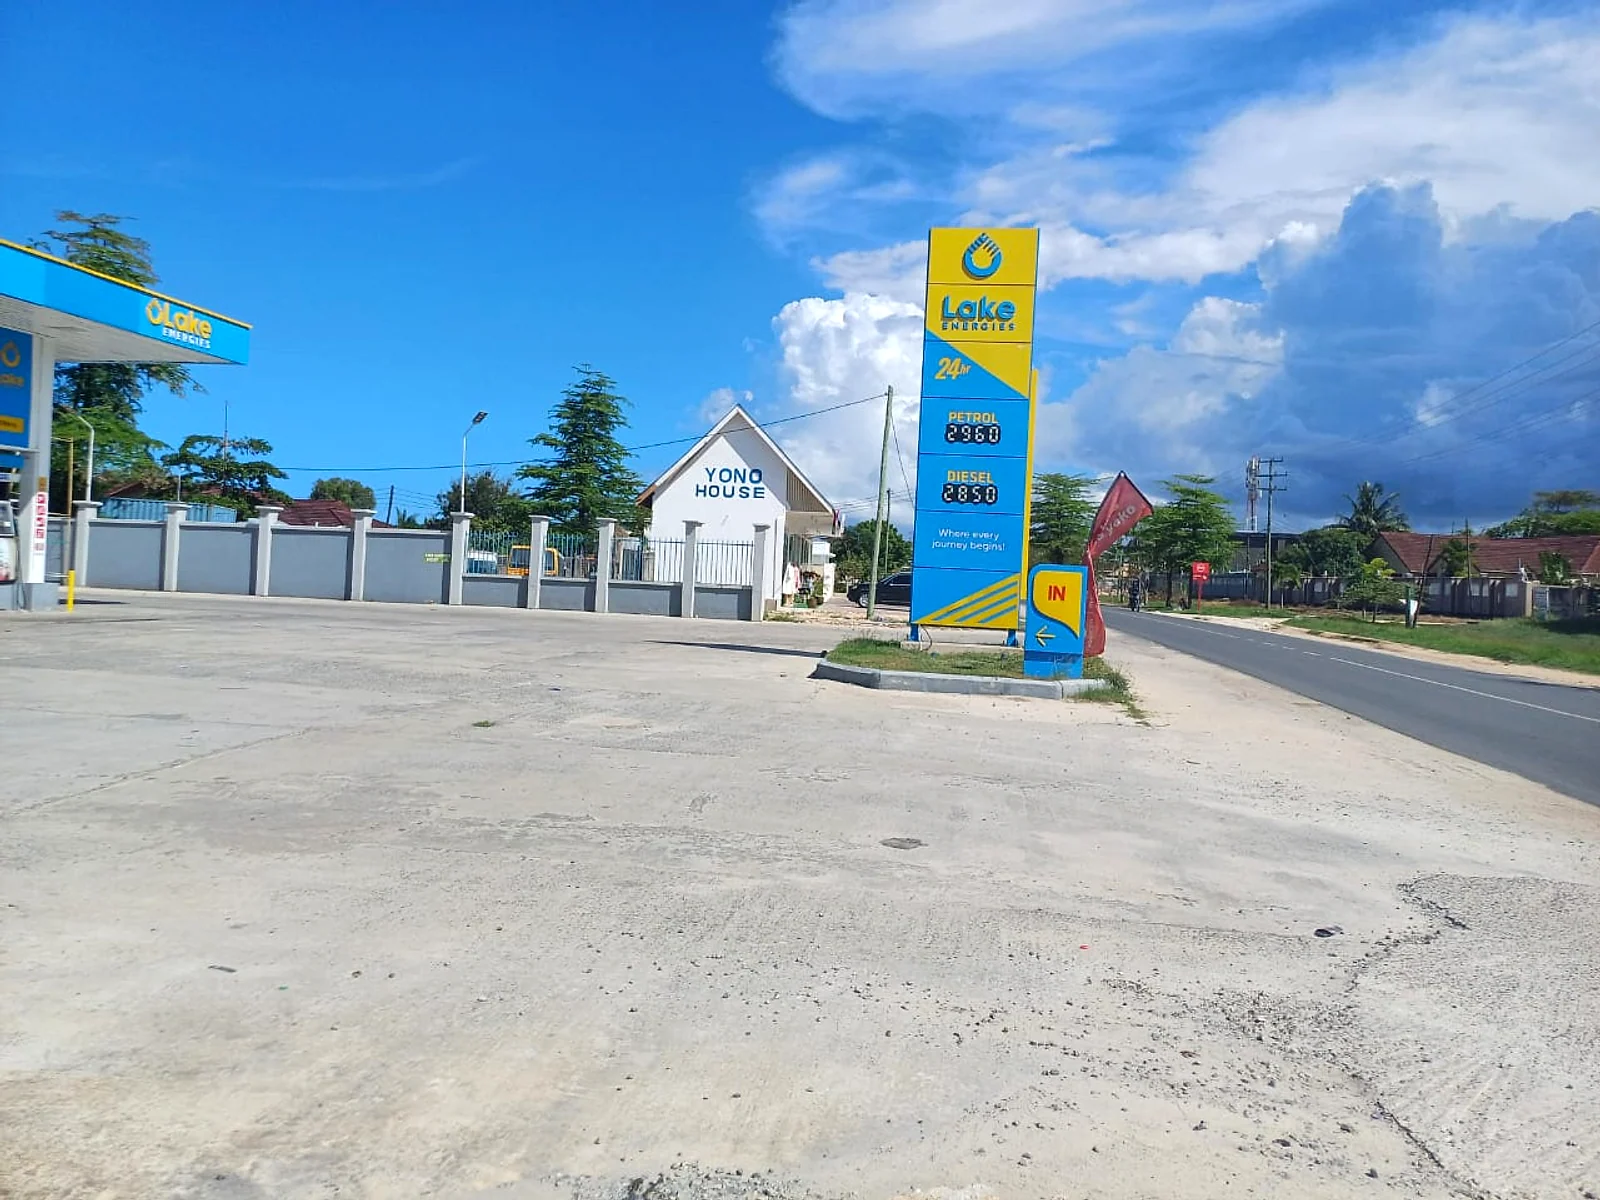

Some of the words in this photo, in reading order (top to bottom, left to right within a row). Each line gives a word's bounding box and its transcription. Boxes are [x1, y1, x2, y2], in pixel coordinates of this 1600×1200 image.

[942, 295, 1016, 321] Lake
[163, 302, 212, 338] Lake
[942, 322, 1016, 332] ENERGIES
[162, 327, 211, 349] ENERGIES
[948, 411, 1000, 424] PETROL
[947, 424, 999, 442] 2960
[705, 467, 763, 484] YONO
[947, 470, 995, 484] DIESEL
[695, 483, 765, 499] HOUSE
[943, 485, 997, 503] 2850
[938, 528, 970, 538] Where
[972, 530, 1000, 541] every
[932, 539, 968, 551] journey
[970, 541, 1005, 553] begins!
[1047, 585, 1067, 602] IN
